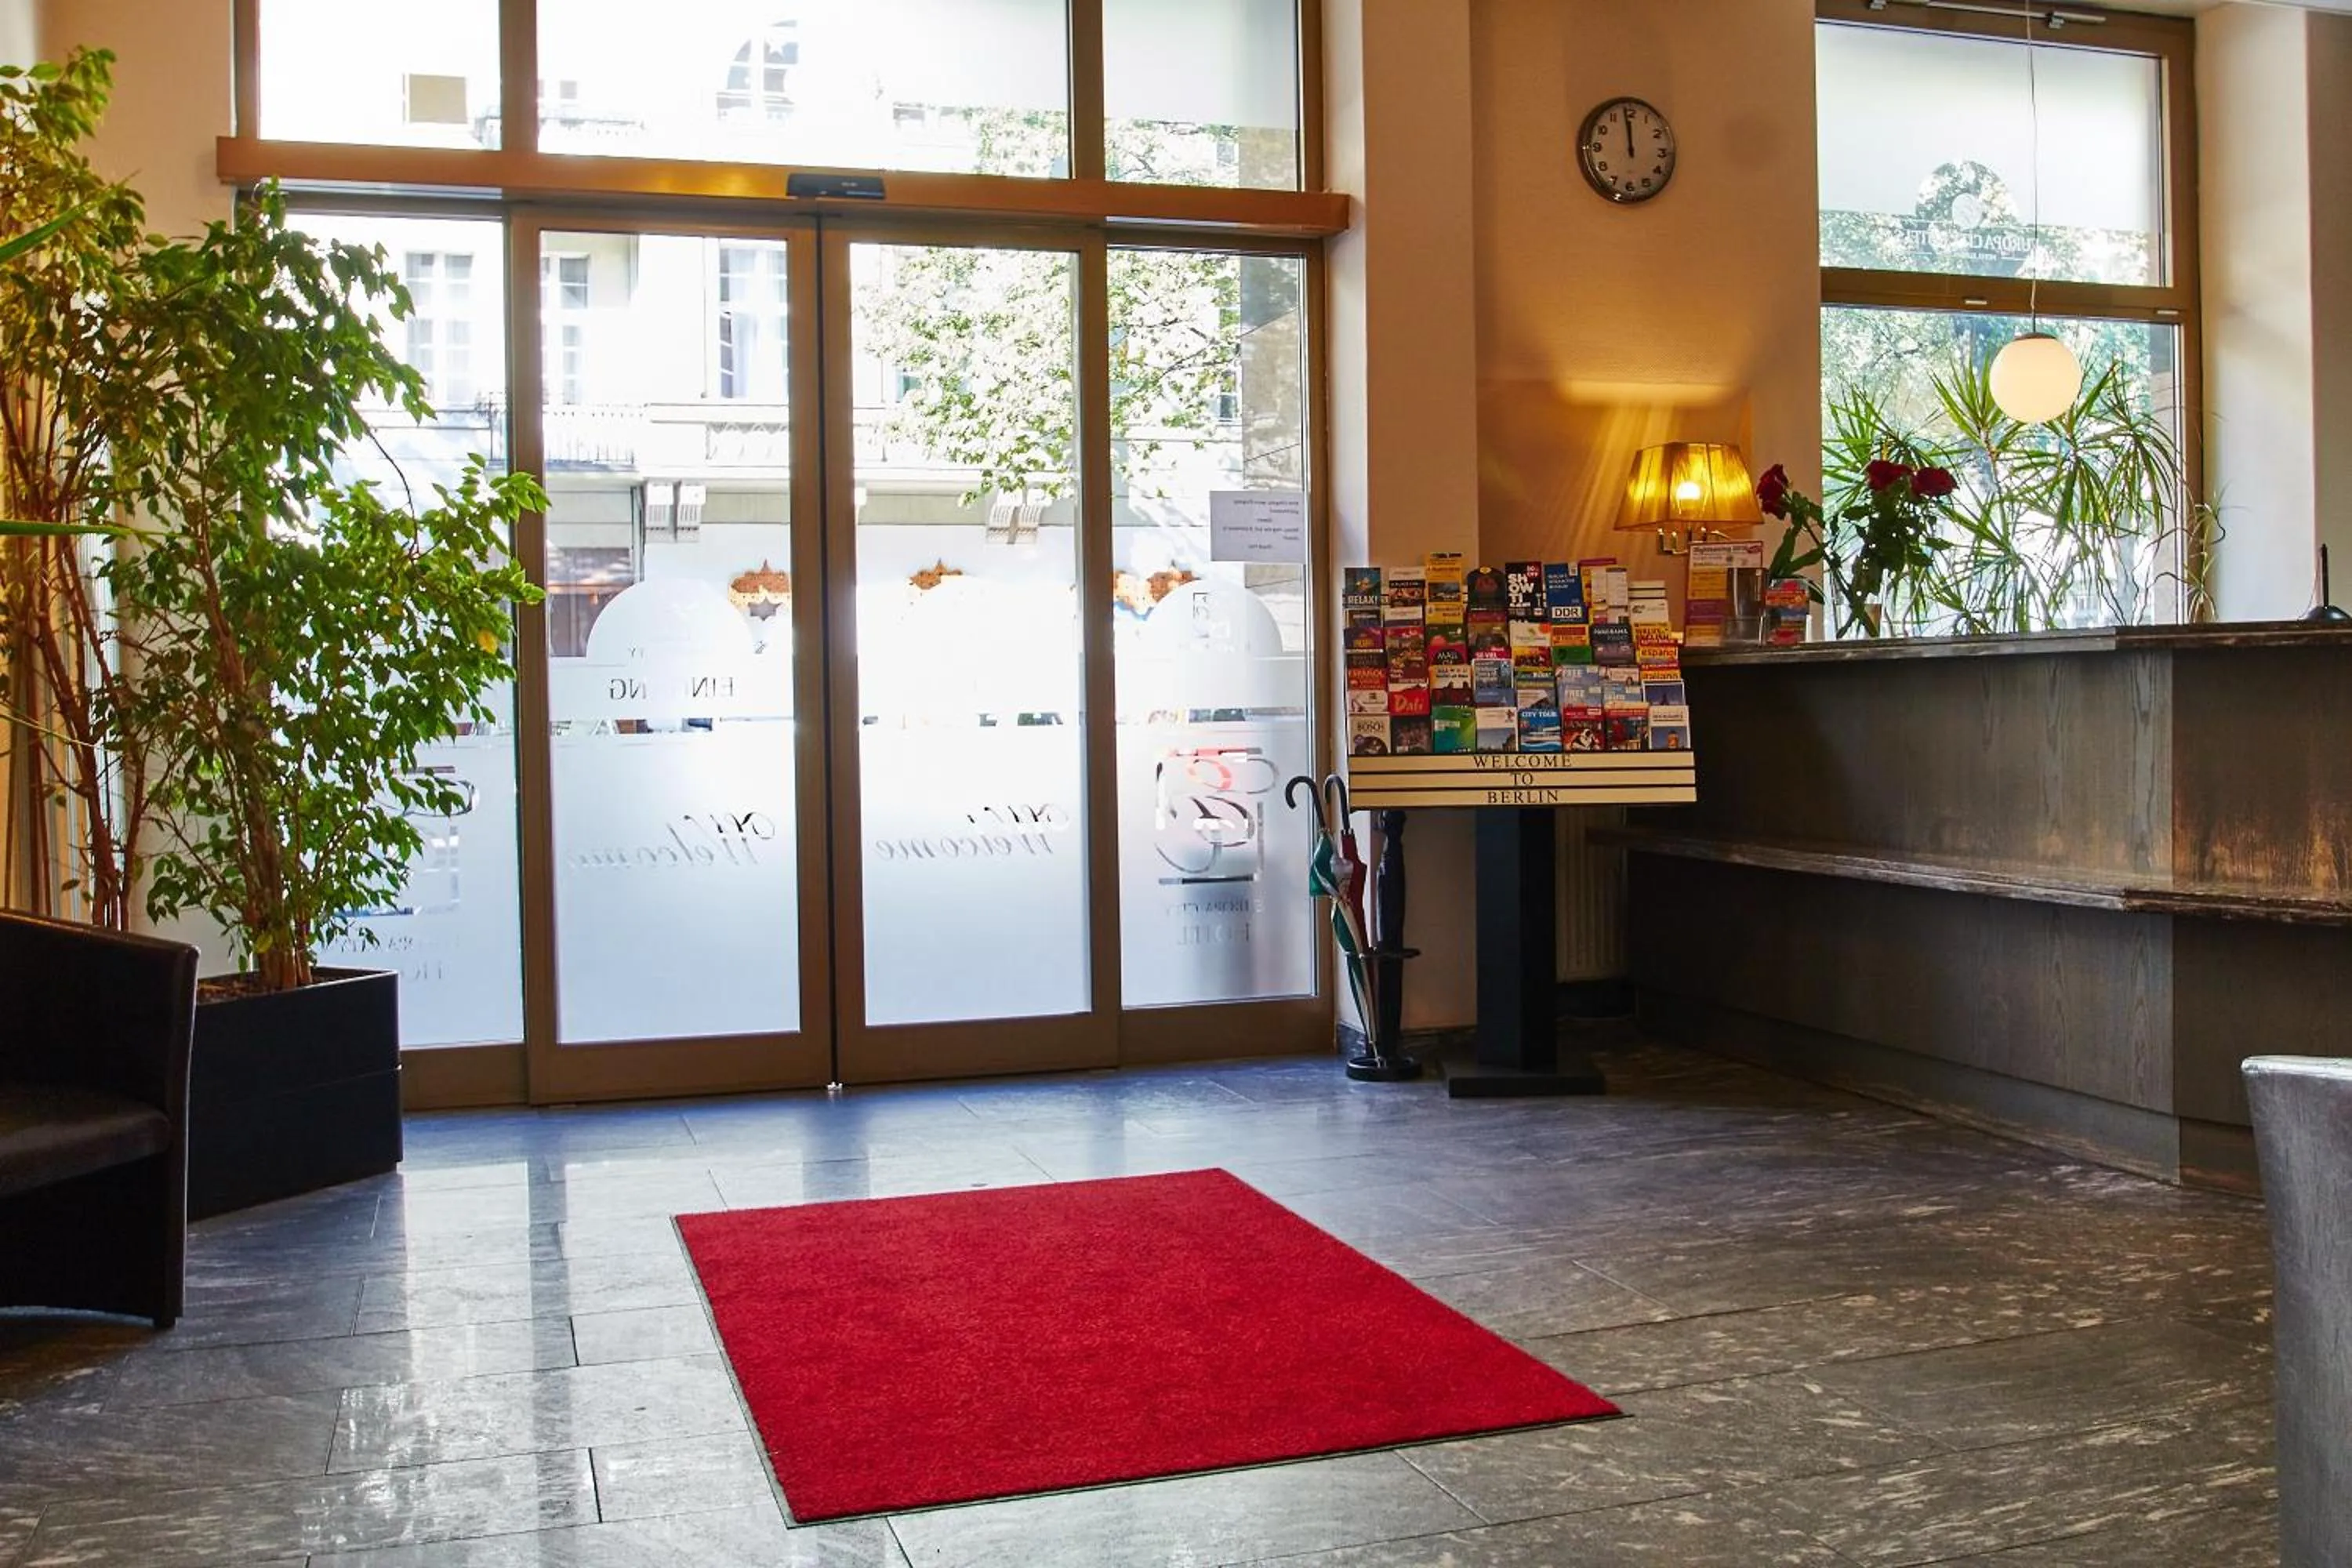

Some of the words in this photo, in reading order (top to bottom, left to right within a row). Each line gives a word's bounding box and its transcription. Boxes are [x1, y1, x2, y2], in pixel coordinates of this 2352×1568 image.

[1653, 129, 1662, 139] 2
[1592, 143, 1602, 152] 9
[1657, 148, 1667, 158] 3
[1598, 162, 1607, 172] 8
[1653, 165, 1662, 175] 4
[1625, 182, 1635, 191] 6
[1642, 178, 1651, 187] 5
[1348, 595, 1377, 604] RELAX!
[1555, 608, 1579, 617] DDR
[1473, 754, 1572, 768] WELCOME
[1510, 772, 1534, 786] TO
[1487, 789, 1559, 804] BERLIN
